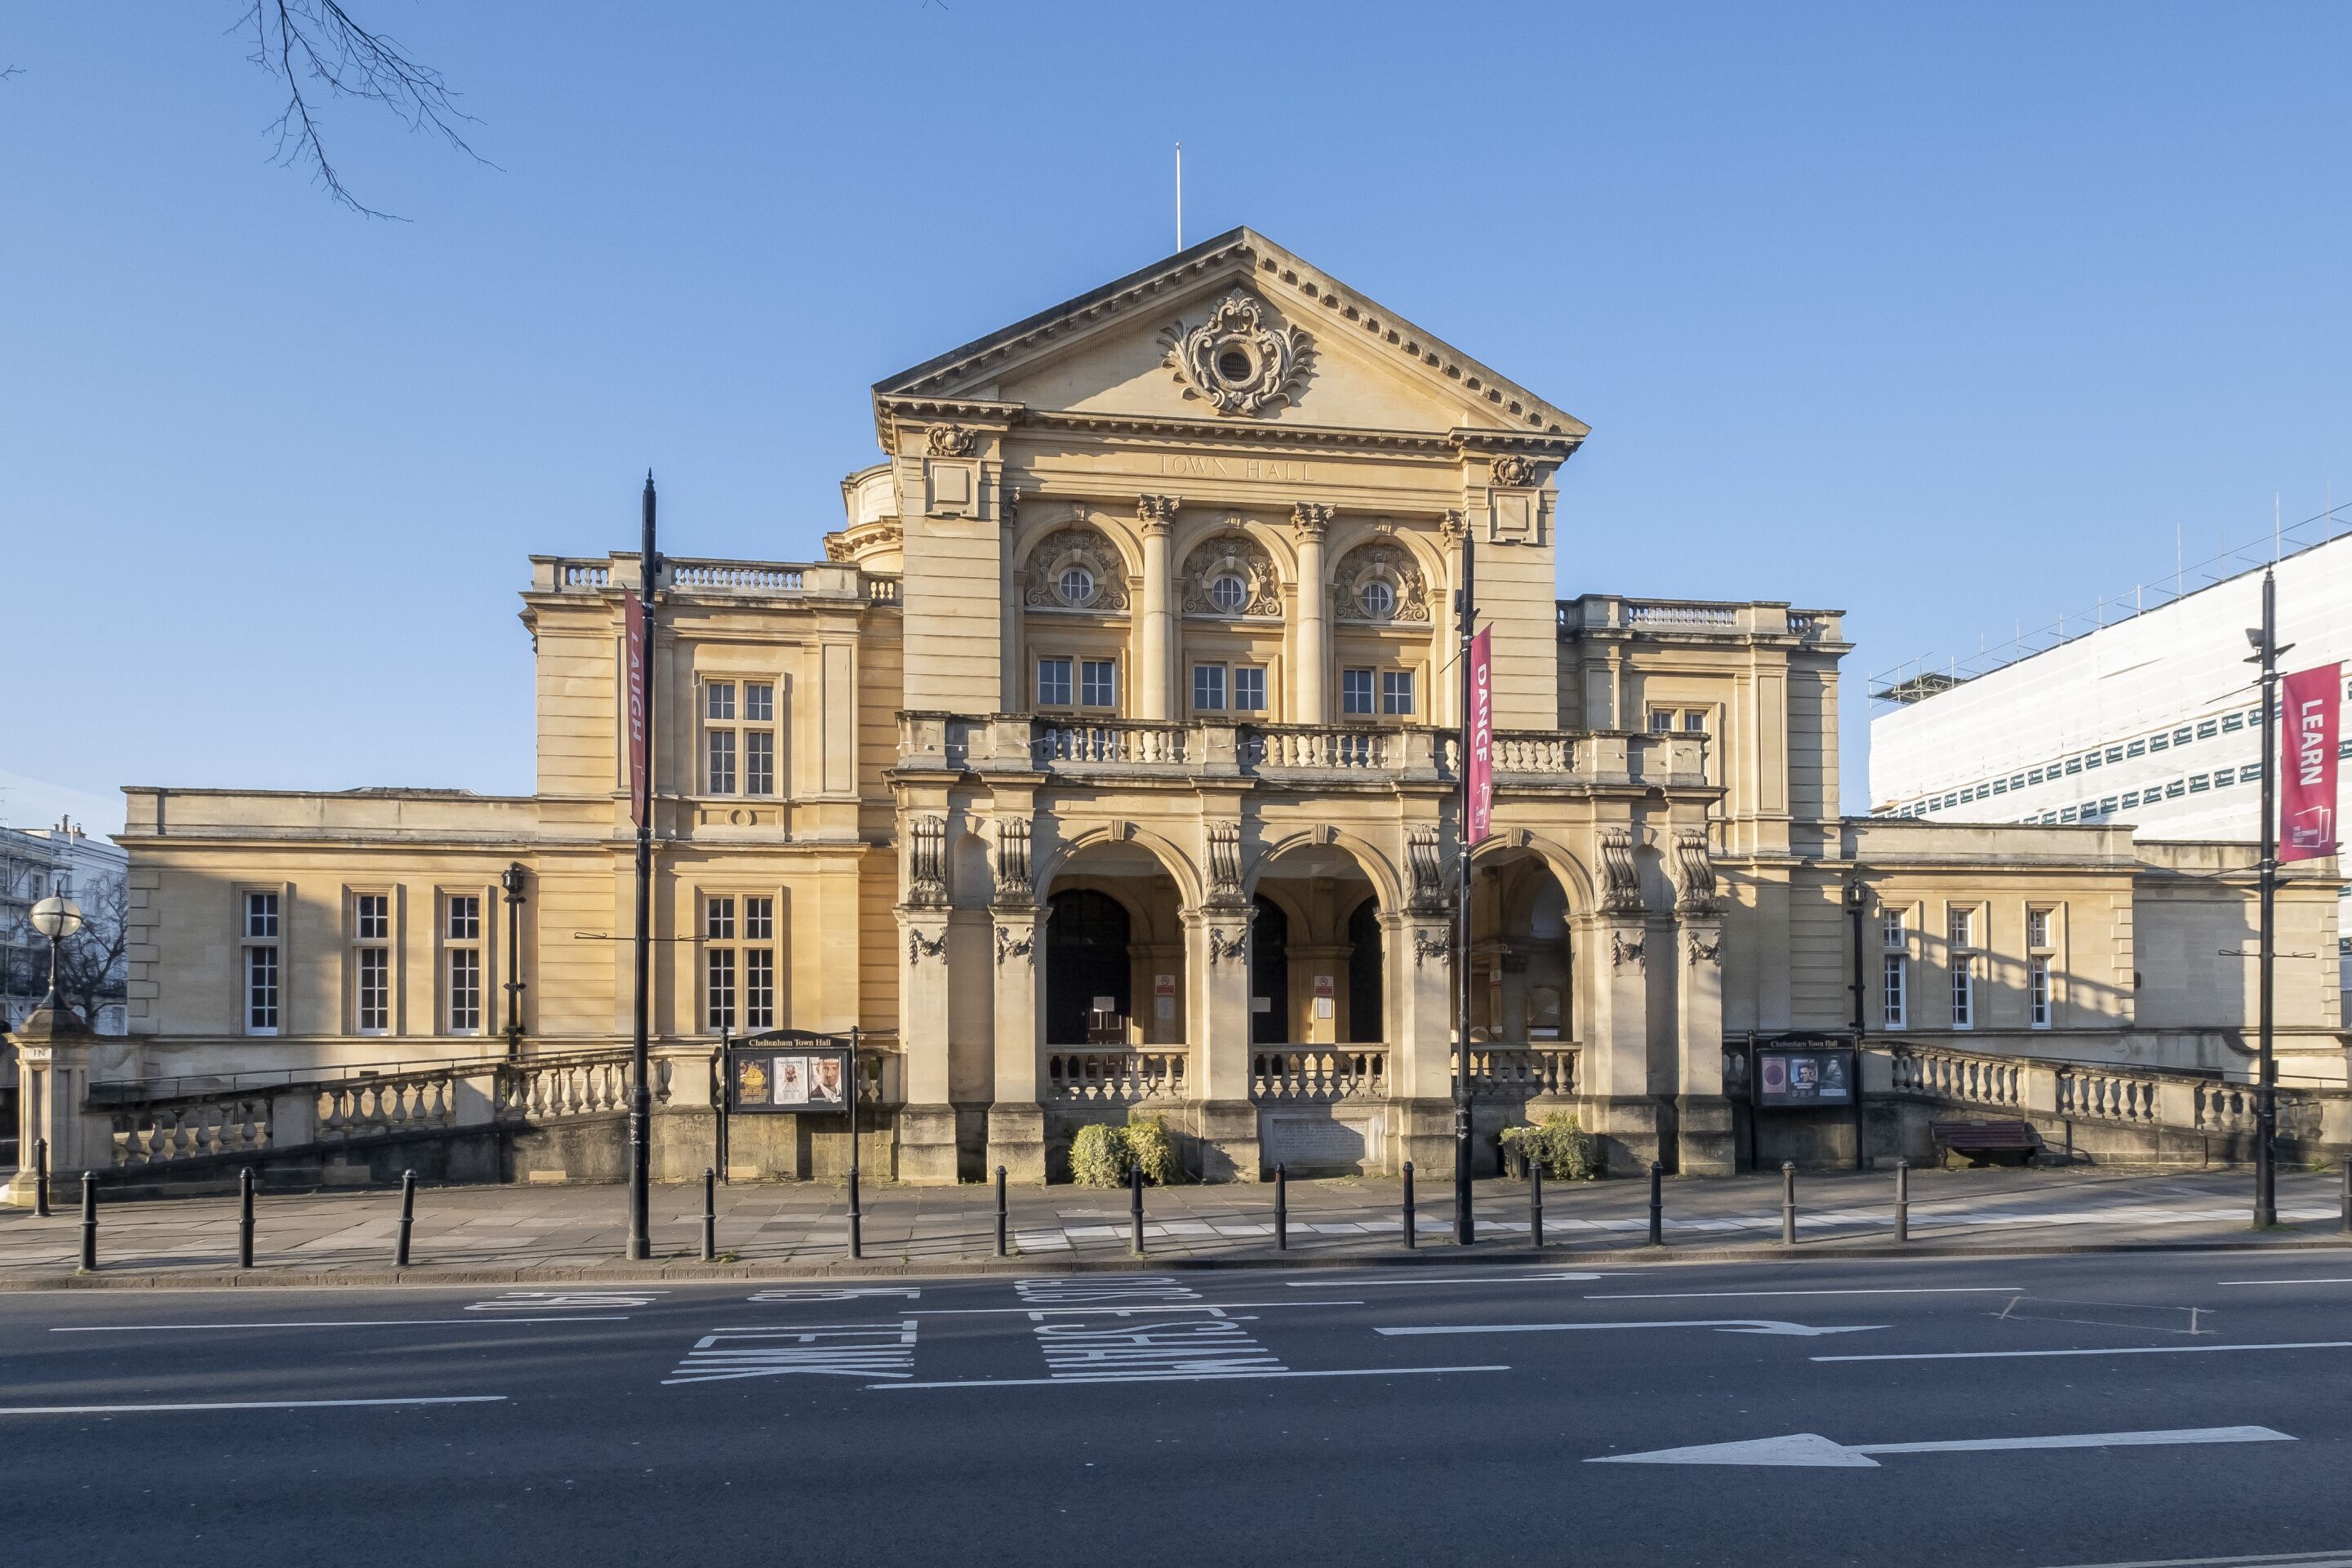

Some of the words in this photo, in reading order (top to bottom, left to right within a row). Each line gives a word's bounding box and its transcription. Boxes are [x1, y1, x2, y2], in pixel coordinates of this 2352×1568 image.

[1156, 455, 1228, 477] TOWN
[1246, 460, 1315, 482] HALL
[630, 630, 642, 742] LAUGH
[2300, 699, 2324, 786] LEARN
[33, 1049, 46, 1057] IN
[749, 1039, 793, 1047] Cheltenham
[794, 1039, 814, 1047] Town
[464, 1290, 671, 1311] A40
[746, 1287, 921, 1302] M5
[1014, 1277, 1203, 1303] GLOS
[660, 1320, 919, 1384] TEWK
[1027, 1307, 1290, 1378] E'SHAM
